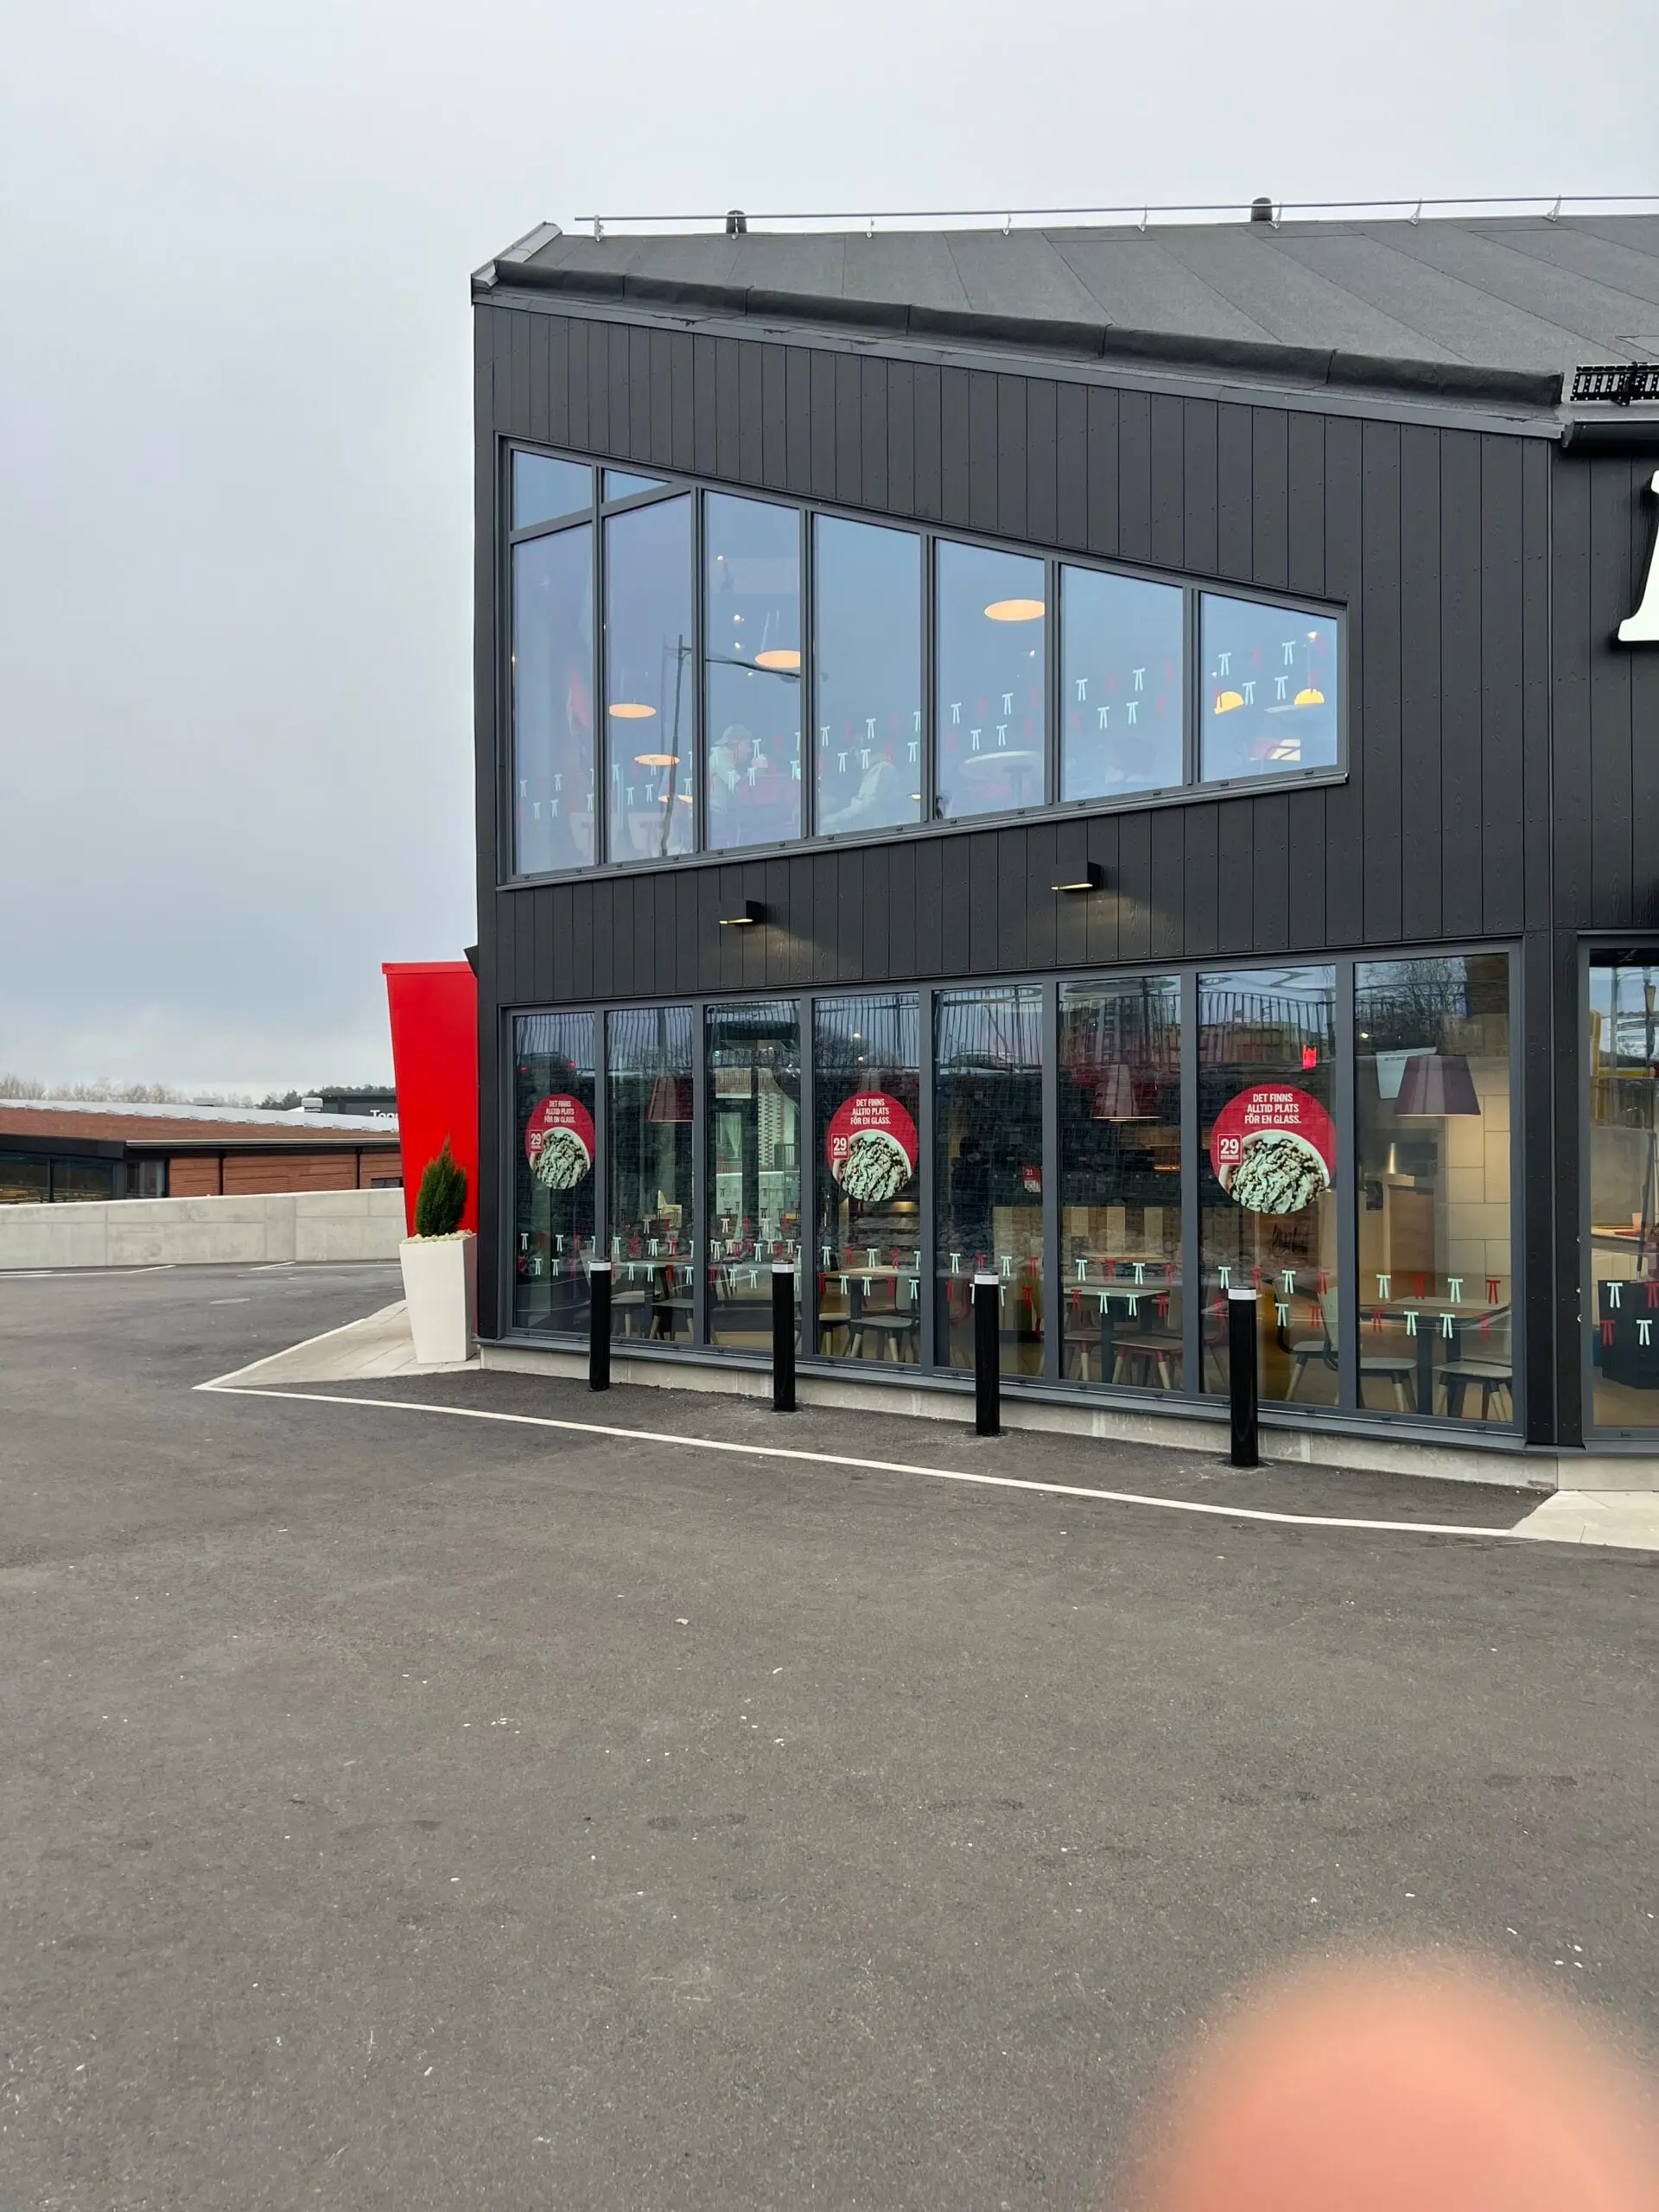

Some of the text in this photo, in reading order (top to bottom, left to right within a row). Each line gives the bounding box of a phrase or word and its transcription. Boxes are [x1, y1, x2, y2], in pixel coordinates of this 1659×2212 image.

[1253, 1093, 1293, 1103] DET FINNS
[872, 1107, 889, 1116] PLATS
[1247, 1103, 1299, 1113] ALLTID PLATS
[850, 1116, 861, 1125] FÖR
[871, 1116, 891, 1125] GLASS.
[1244, 1113, 1301, 1124] FÖR EN GLASS.
[531, 1133, 541, 1145] 29
[833, 1137, 847, 1151] 29
[1220, 1138, 1239, 1154] 29
